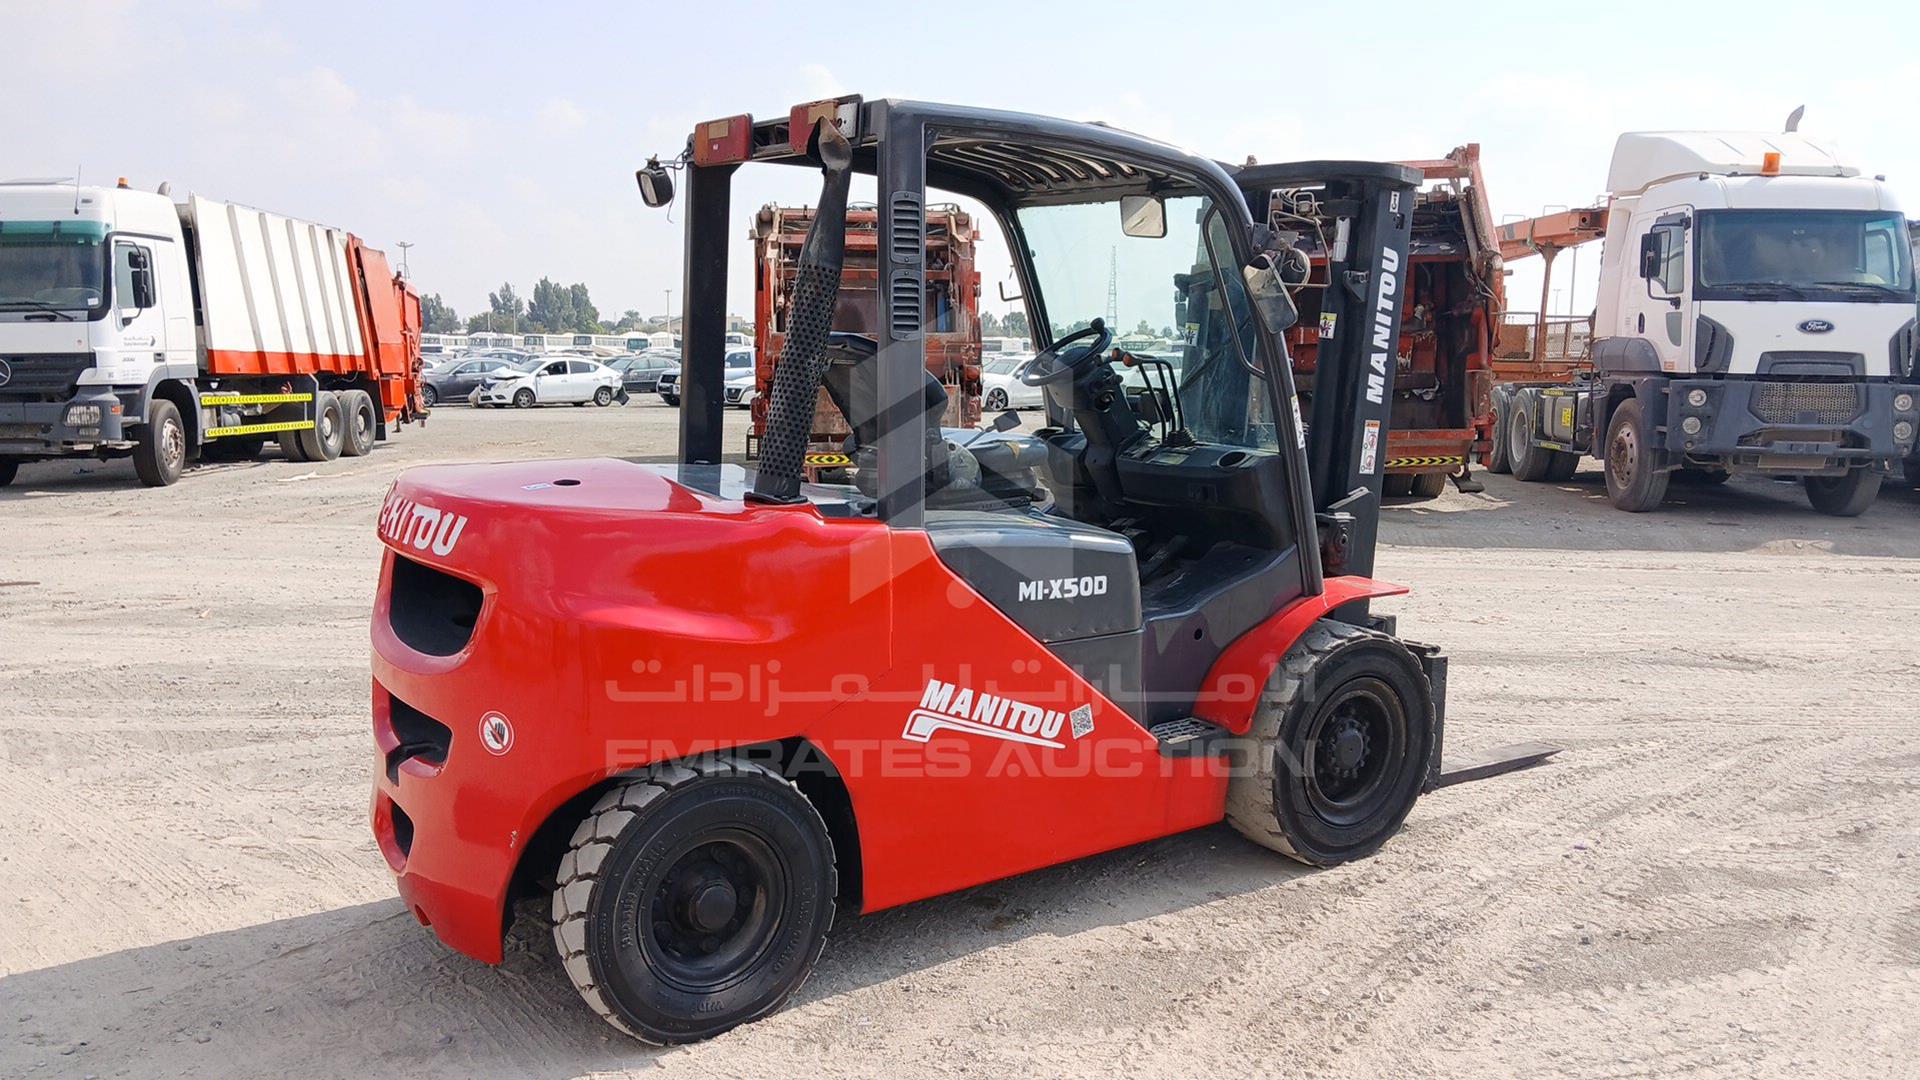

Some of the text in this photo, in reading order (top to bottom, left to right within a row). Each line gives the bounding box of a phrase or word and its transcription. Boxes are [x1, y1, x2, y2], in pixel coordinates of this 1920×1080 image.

[1366, 246, 1399, 405] MANITOU
[1018, 575, 1108, 602] MI-X50D
[920, 678, 1066, 739] MANITOU
